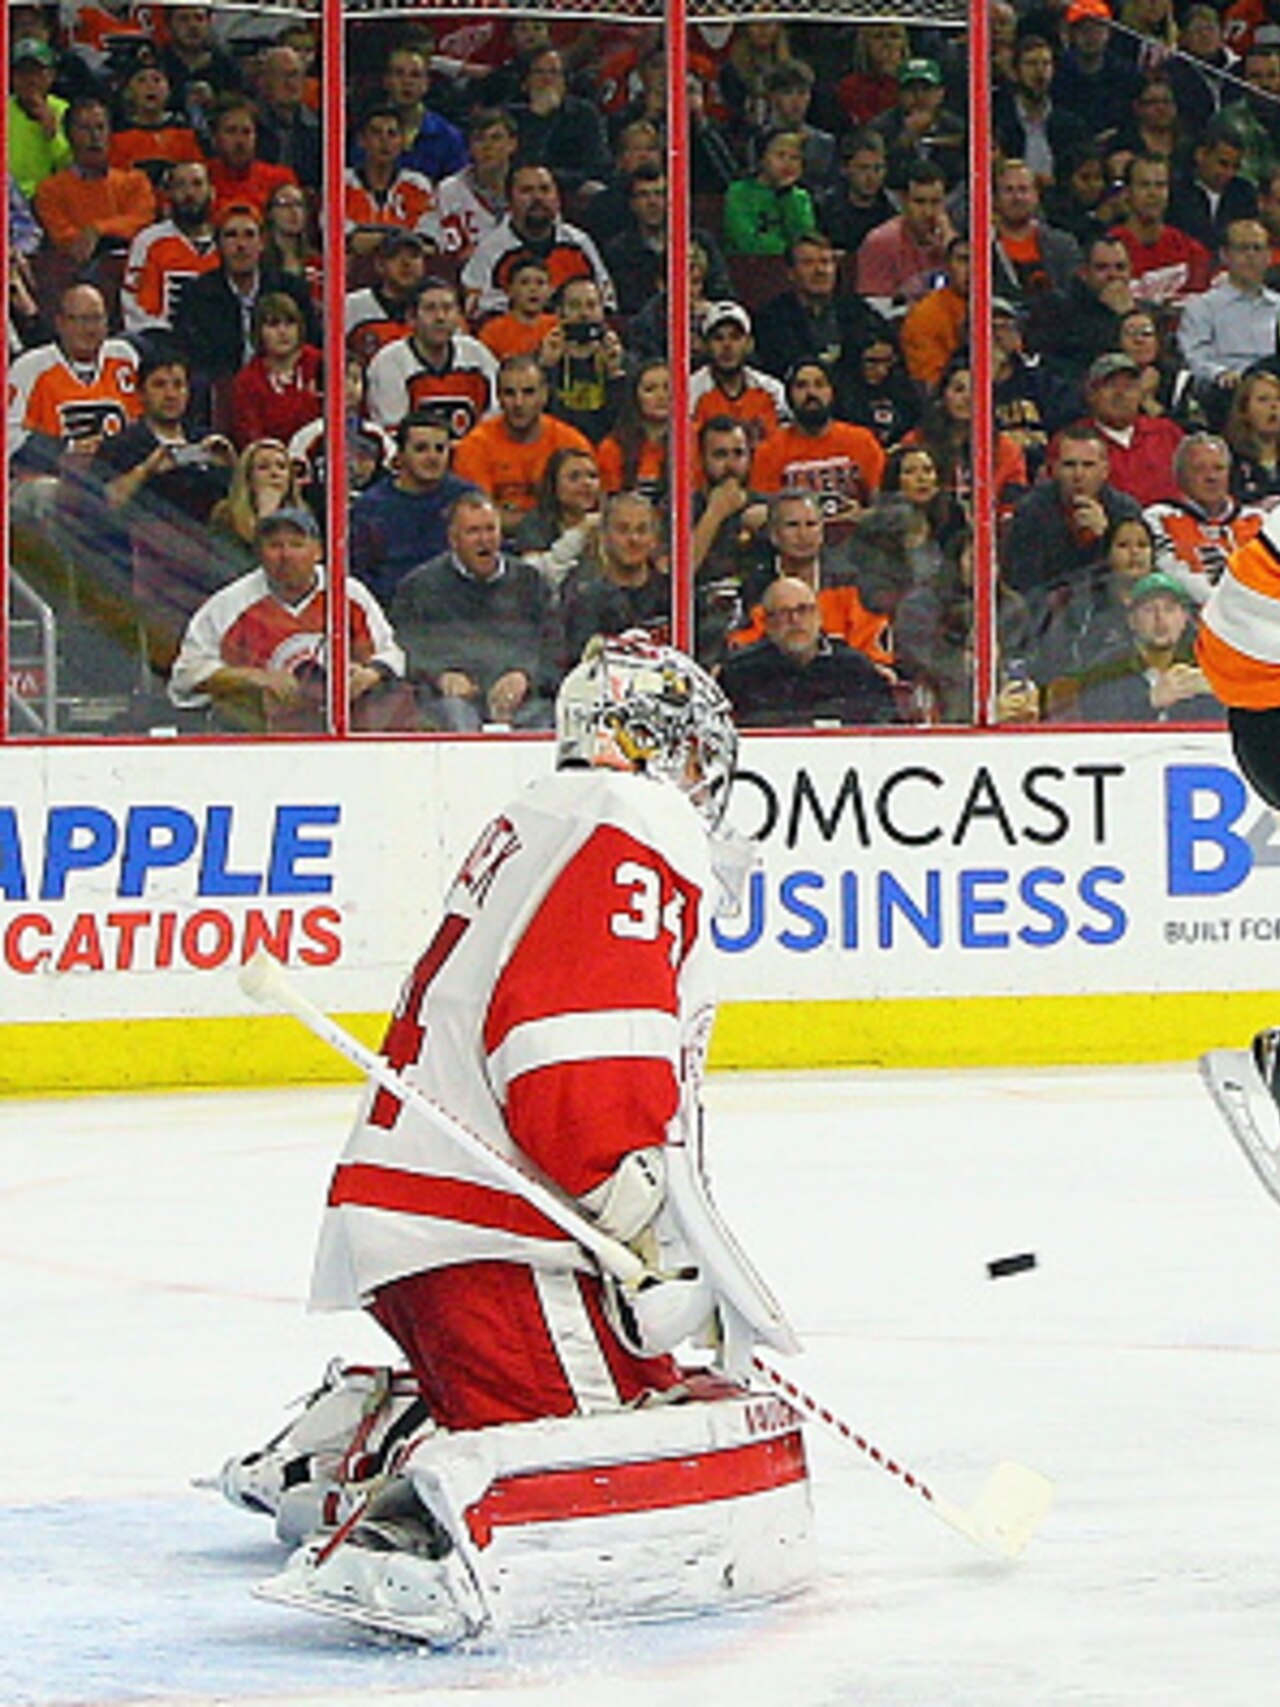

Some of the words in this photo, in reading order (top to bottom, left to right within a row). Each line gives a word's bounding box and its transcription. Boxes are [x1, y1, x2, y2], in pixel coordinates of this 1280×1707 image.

[709, 765, 1126, 850] OMCAST
[710, 865, 1128, 952] USINESS
[1164, 918, 1233, 943] BUILT
